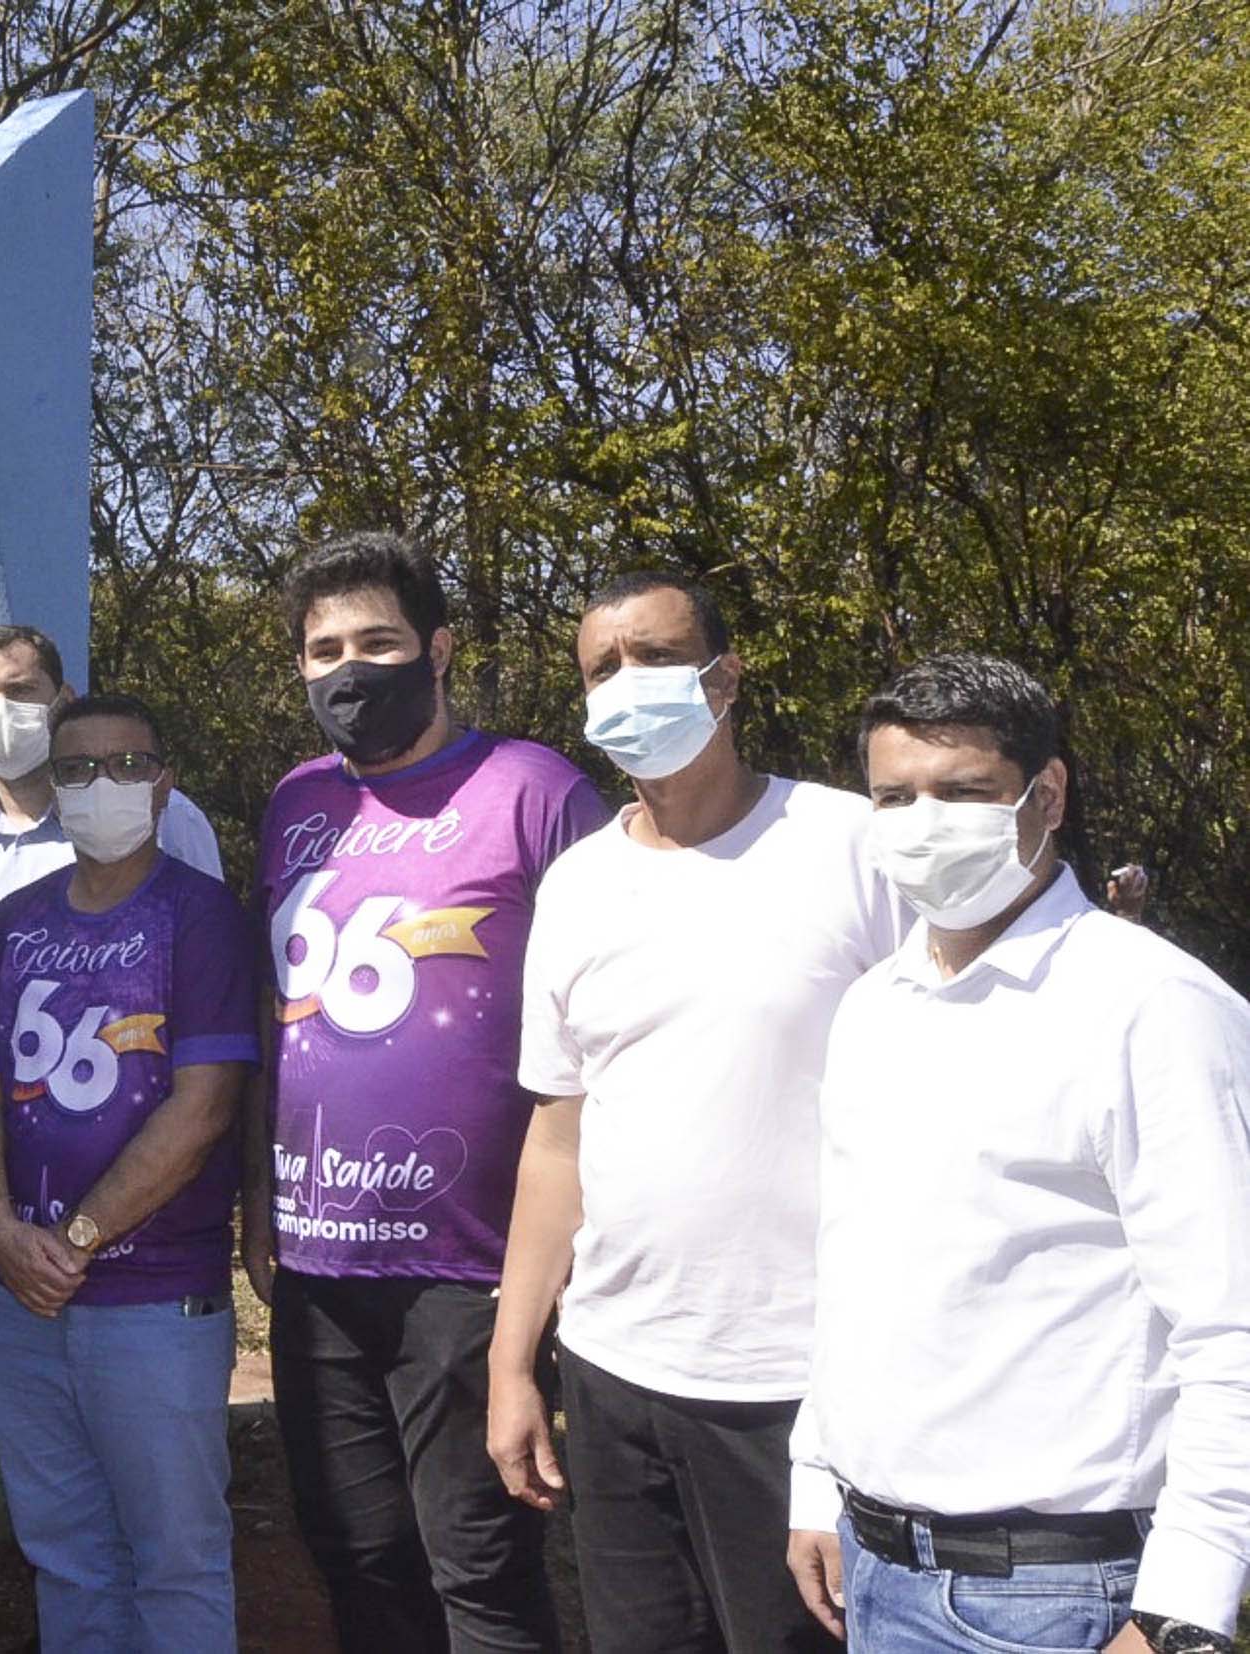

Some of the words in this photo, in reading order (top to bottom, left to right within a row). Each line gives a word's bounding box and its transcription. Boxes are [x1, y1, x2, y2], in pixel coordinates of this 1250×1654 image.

[281, 808, 466, 879] Goioerê
[7, 928, 148, 977] Goioerê
[271, 870, 416, 1034] 66
[11, 980, 119, 1112] 66
[316, 1147, 436, 1190] Saúde
